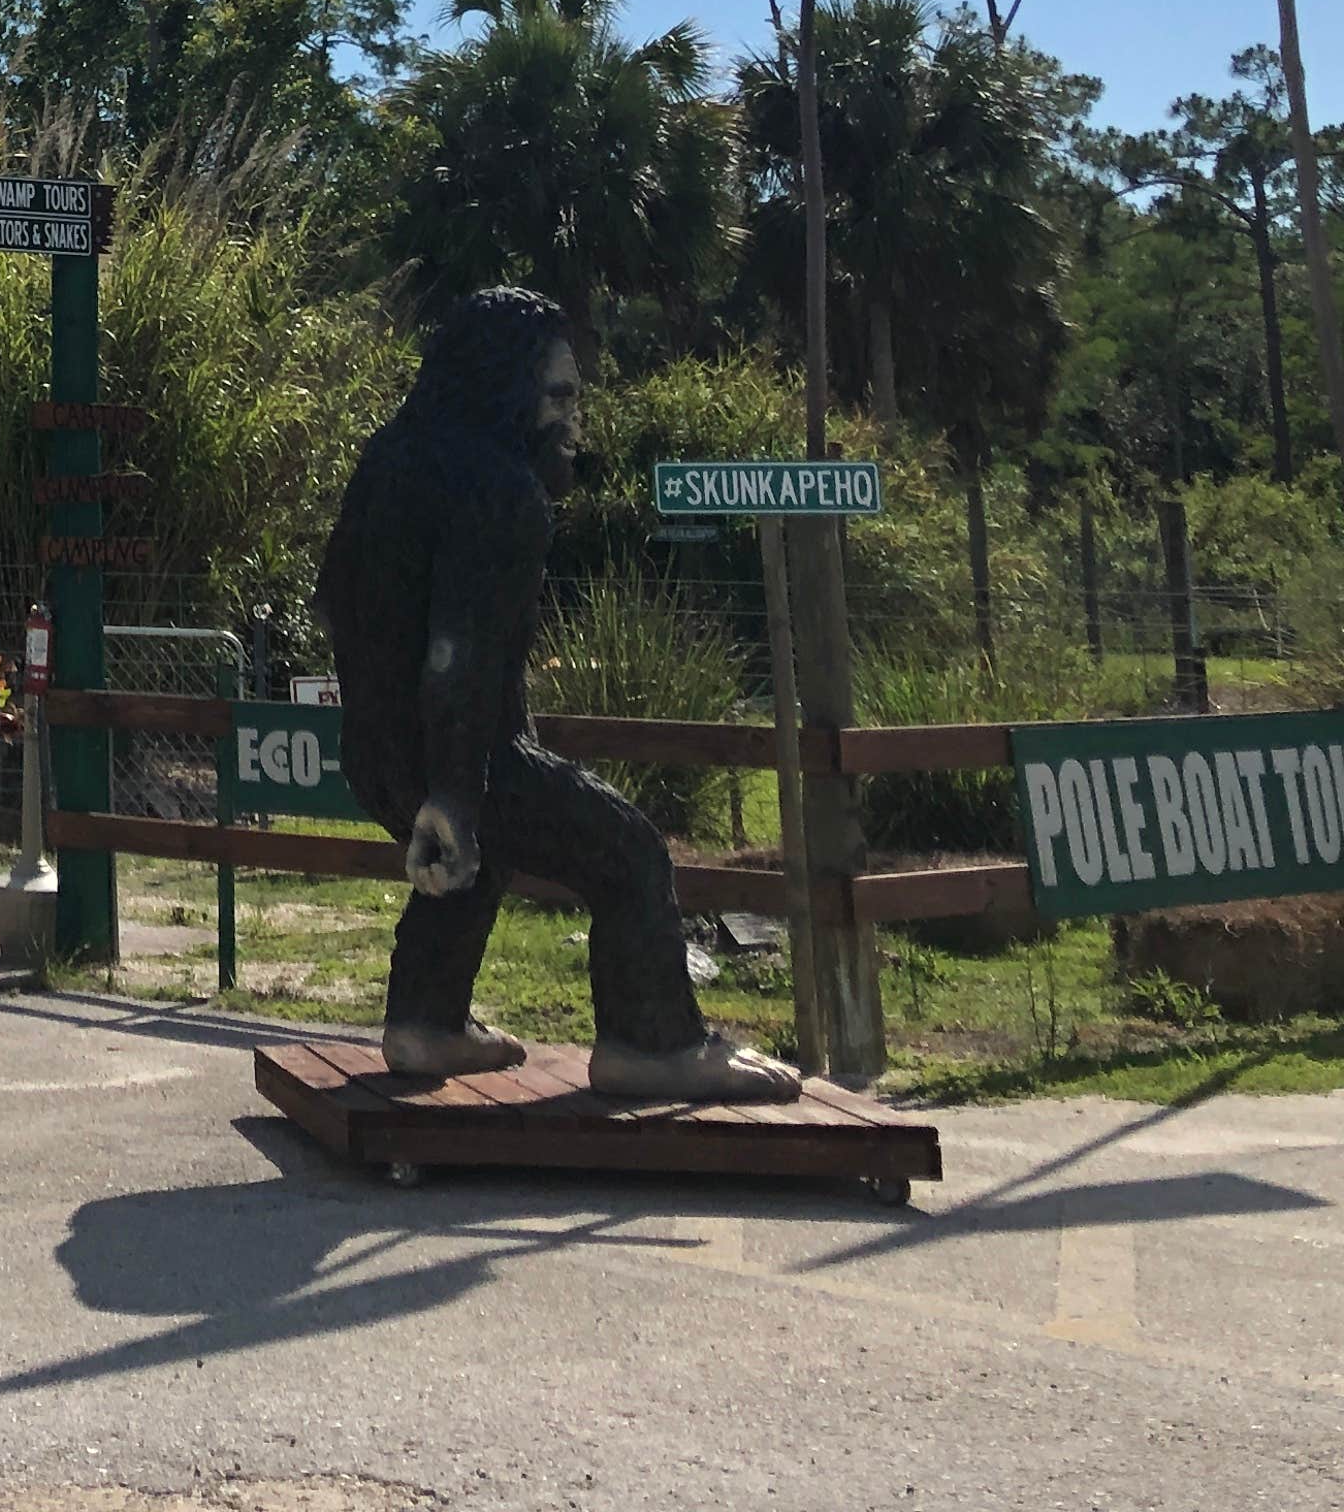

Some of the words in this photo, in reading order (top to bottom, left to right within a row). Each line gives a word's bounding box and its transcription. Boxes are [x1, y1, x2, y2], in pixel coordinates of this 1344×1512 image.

[42, 184, 87, 213] TOURS
[31, 227, 41, 246] &
[43, 222, 88, 251] SNAKES
[663, 469, 874, 508] #SKUNKAPEHQ
[236, 727, 342, 788] ECO-
[1024, 757, 1157, 887] POLE
[1146, 750, 1276, 877] BOAT
